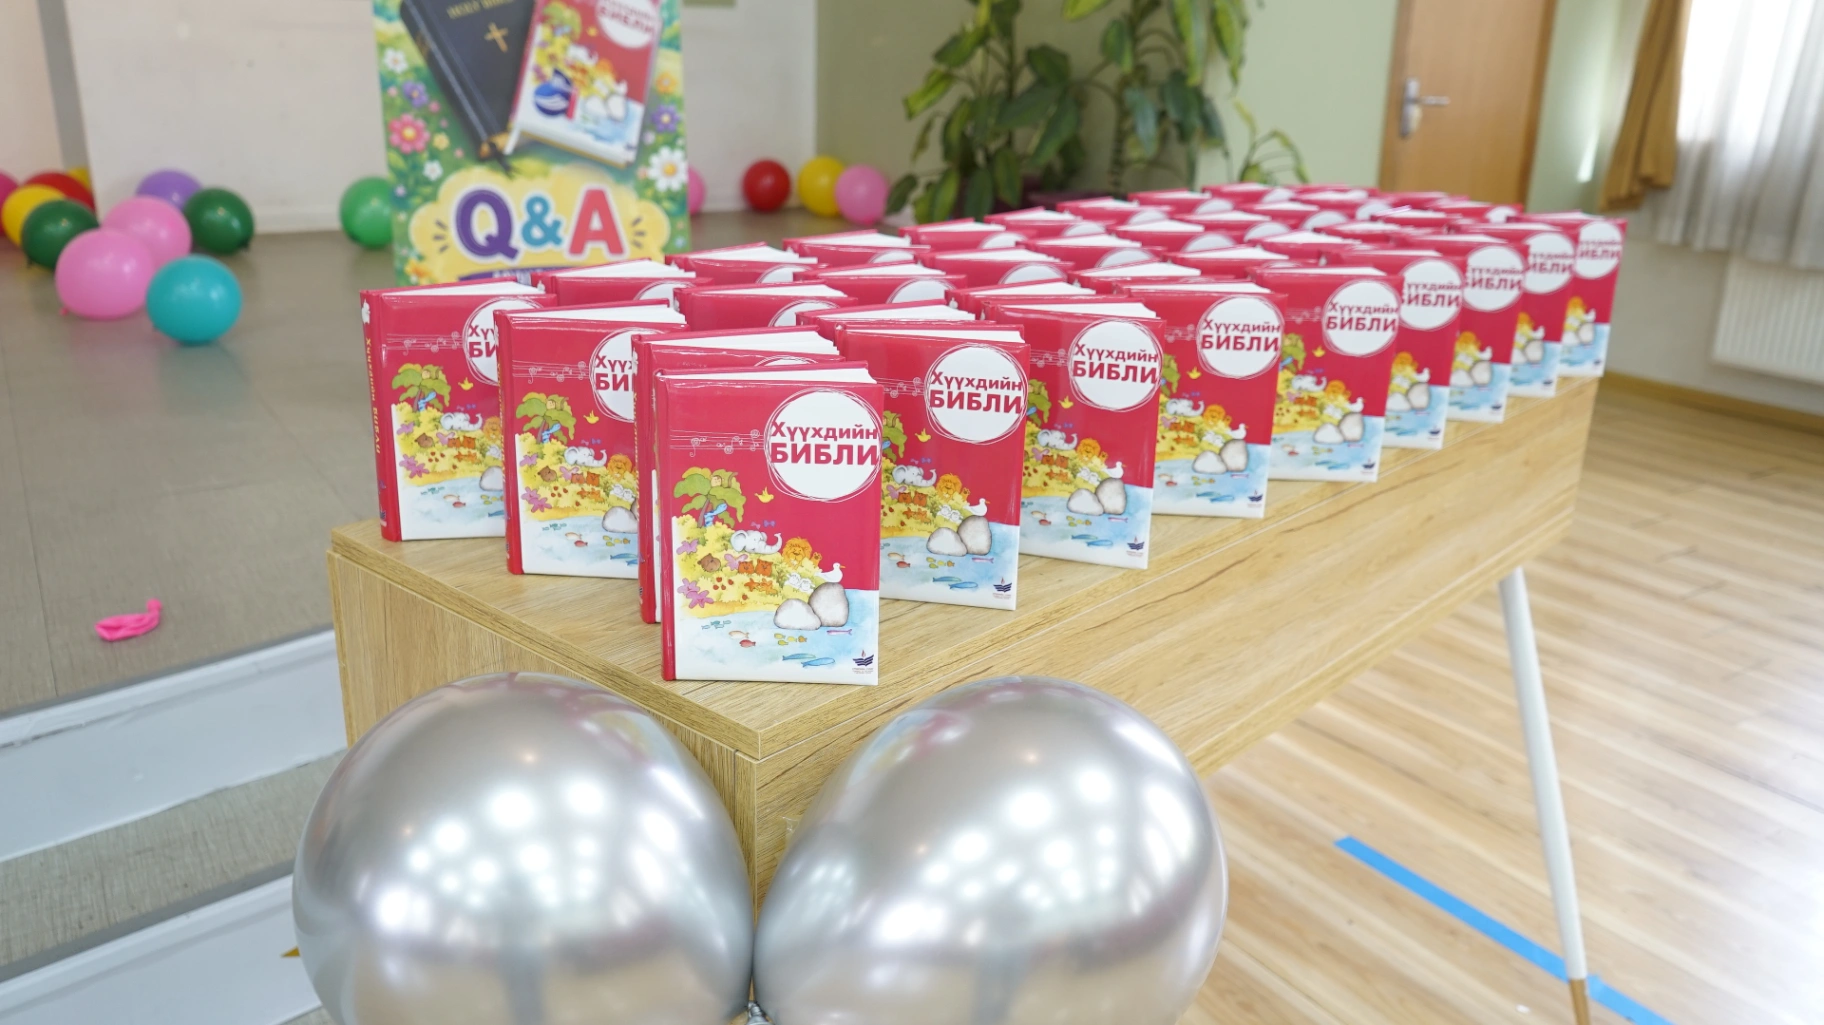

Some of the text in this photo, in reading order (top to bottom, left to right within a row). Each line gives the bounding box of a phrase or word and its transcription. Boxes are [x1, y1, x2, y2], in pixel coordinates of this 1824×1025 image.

[456, 189, 624, 260] Q&A
[1406, 281, 1461, 293] үүхдийн
[1466, 277, 1522, 290] ИБЛИ
[1202, 319, 1281, 334] Хүүхдийн
[1326, 316, 1397, 332] БИБЛИ
[1200, 335, 1280, 352] БИБЛИ
[1074, 344, 1158, 363] Хүүхдийн
[930, 371, 1023, 391] Хүүхдийн
[1072, 360, 1159, 384] БИБЛИ
[595, 373, 634, 392] БИ
[929, 390, 1023, 414] БИБЛИ
[770, 421, 878, 442] Хүүхдийн
[770, 442, 879, 466] БИБЛИ
